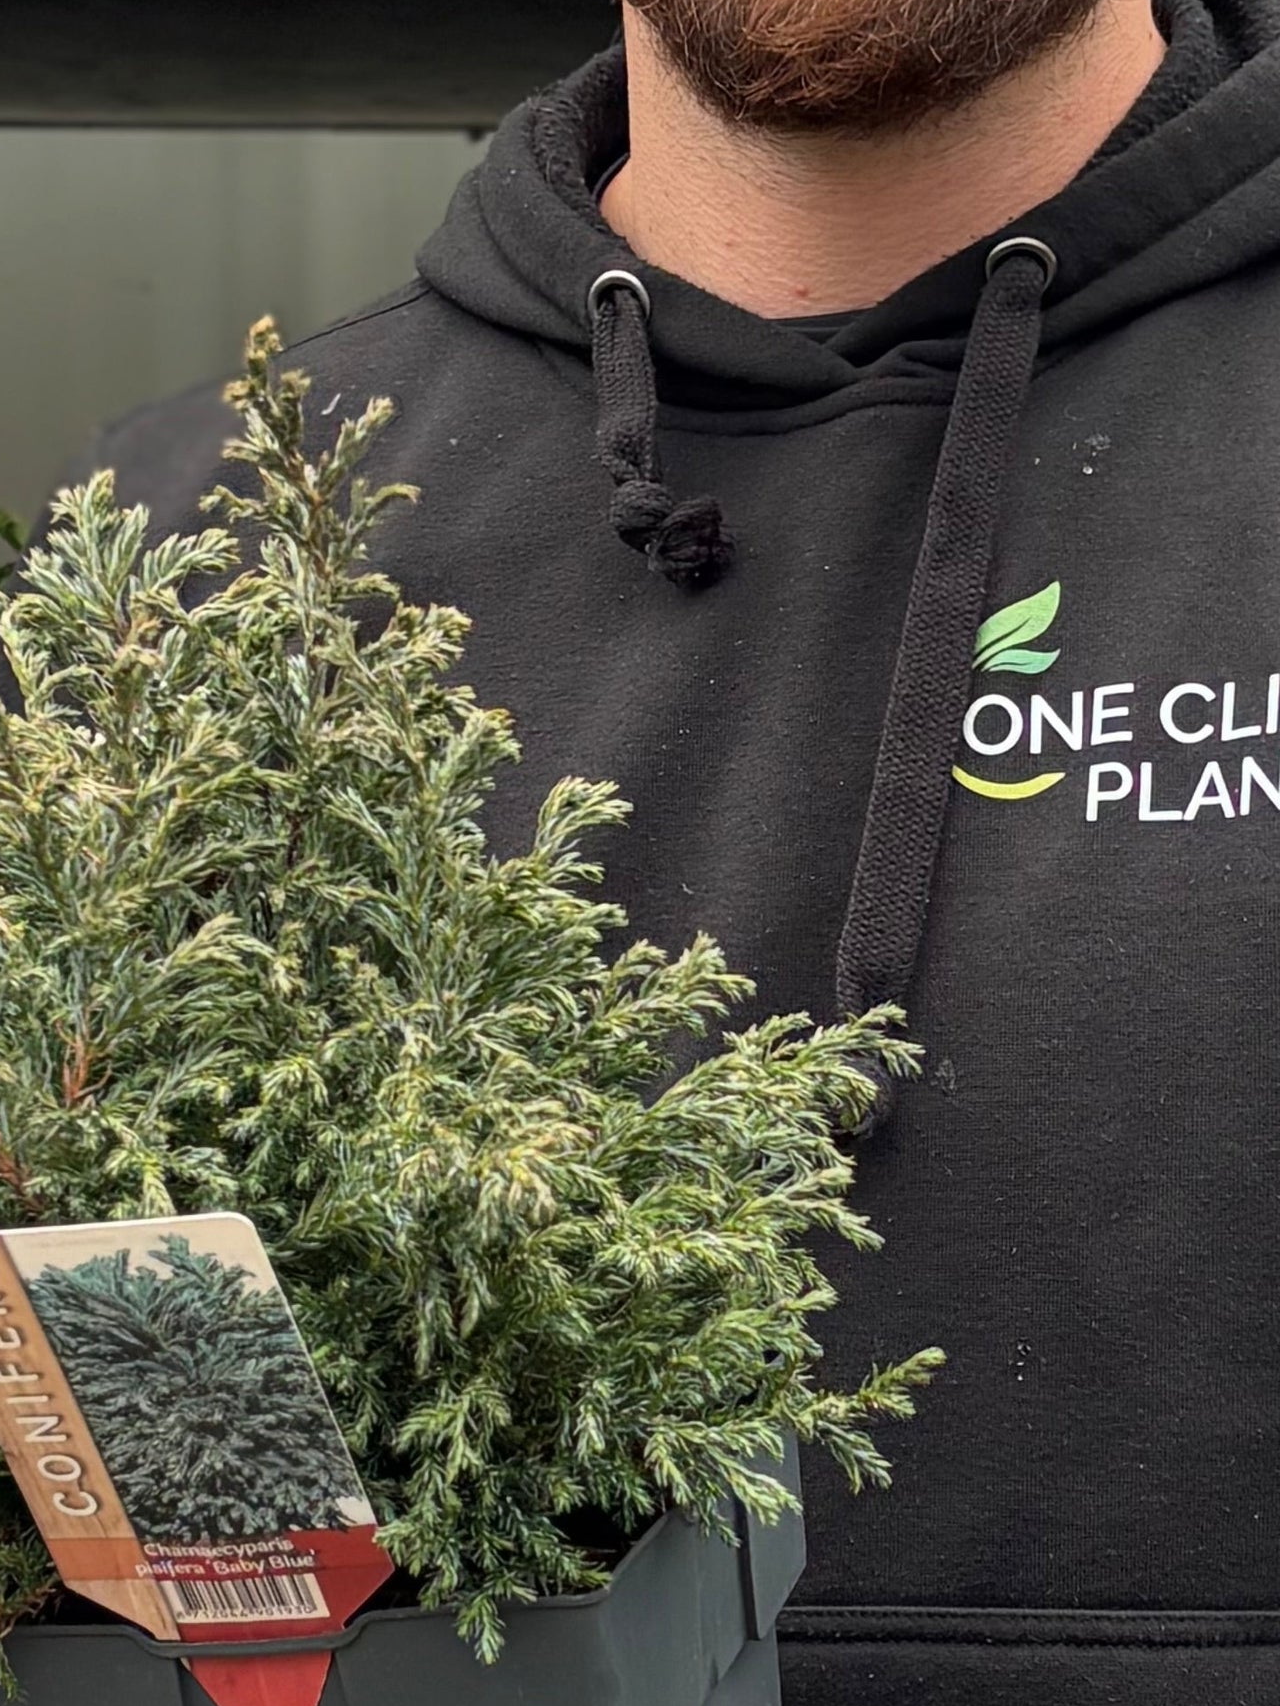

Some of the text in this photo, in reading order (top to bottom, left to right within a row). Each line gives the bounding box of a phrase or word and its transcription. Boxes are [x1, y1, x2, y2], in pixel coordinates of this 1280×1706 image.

[963, 682, 1135, 756] ONE
[143, 1537, 295, 1558] Chamaecyparis
[134, 1560, 205, 1578] pisifera
